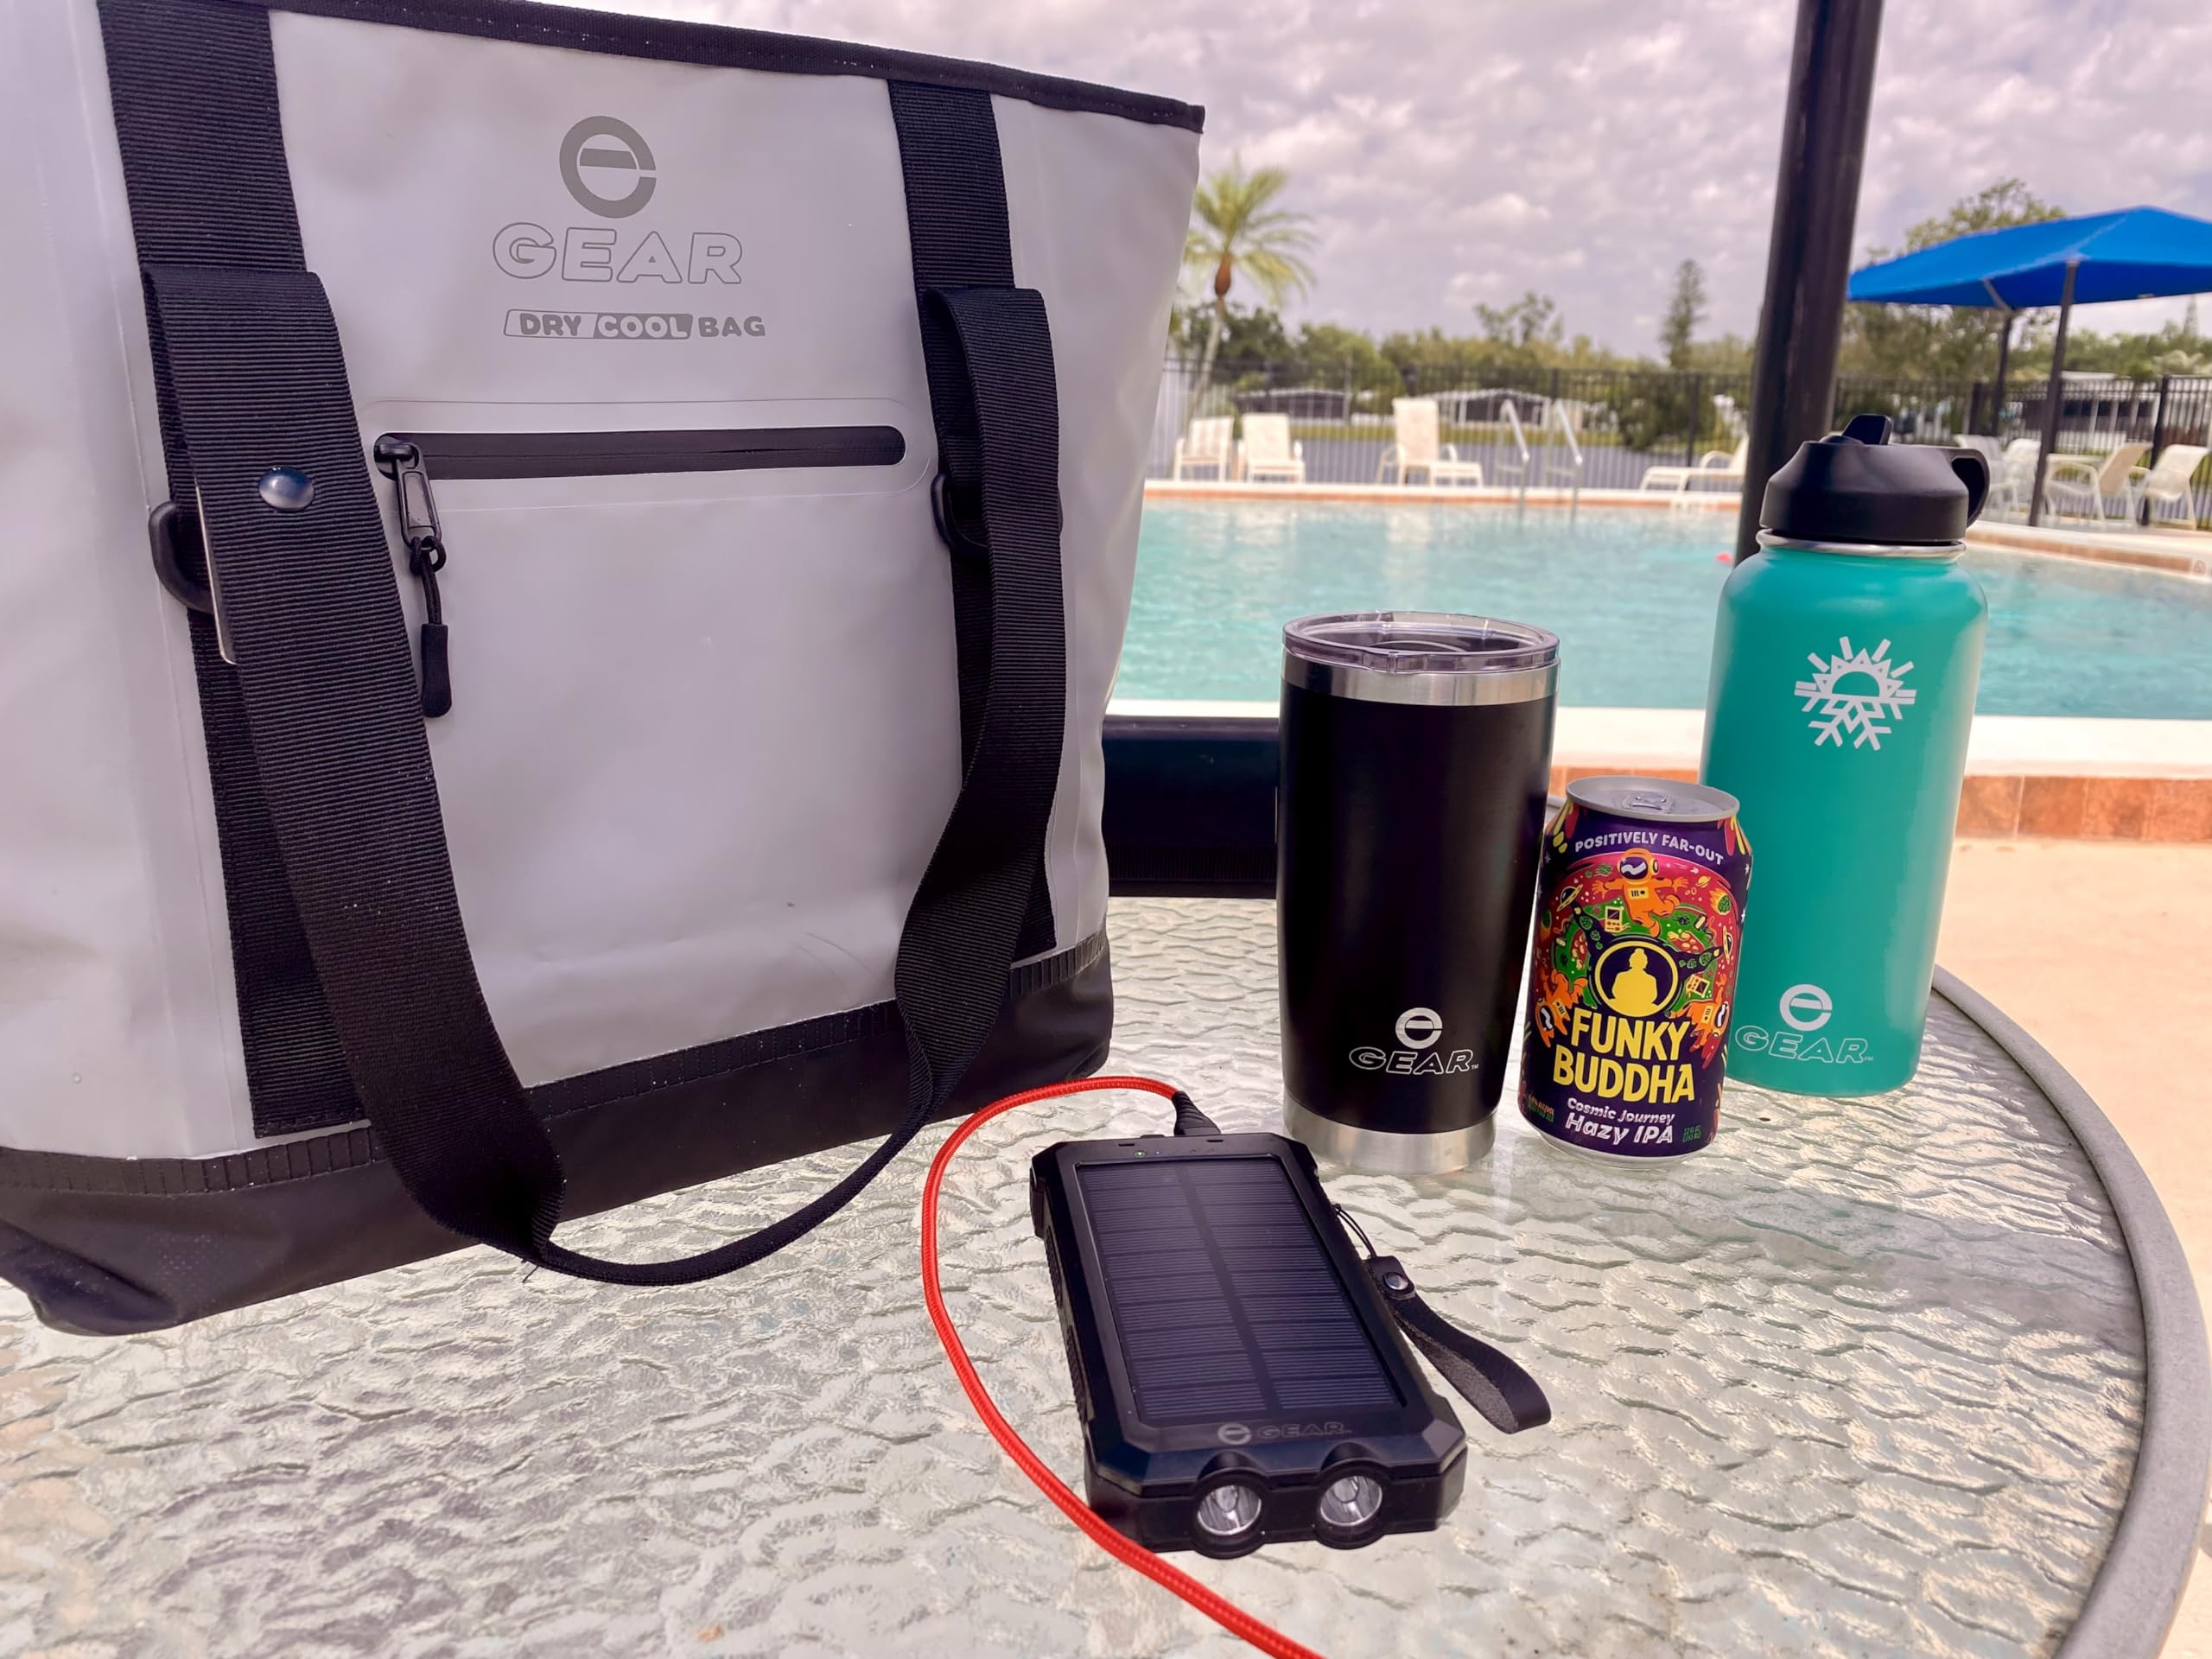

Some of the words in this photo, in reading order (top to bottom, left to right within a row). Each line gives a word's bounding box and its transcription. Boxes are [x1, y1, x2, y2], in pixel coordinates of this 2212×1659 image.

[493, 221, 743, 284] GEAR
[519, 313, 582, 336] DRY
[597, 315, 689, 338] COOL
[698, 315, 766, 338] BAG
[1575, 831, 1658, 852] POSITIVELY
[1662, 834, 1724, 866] FAR-OUT
[1571, 1007, 1691, 1061] FUNKY
[1734, 1025, 1868, 1064] GEAR
[1348, 1046, 1474, 1075] GEAR
[1553, 1044, 1695, 1103] BUDDHA
[1567, 1097, 1617, 1120] Cosmic
[1618, 1109, 1675, 1126] Journey
[1565, 1112, 1630, 1146] Hazy
[1633, 1125, 1674, 1145] IPA
[1256, 1421, 1344, 1440] GEAR
